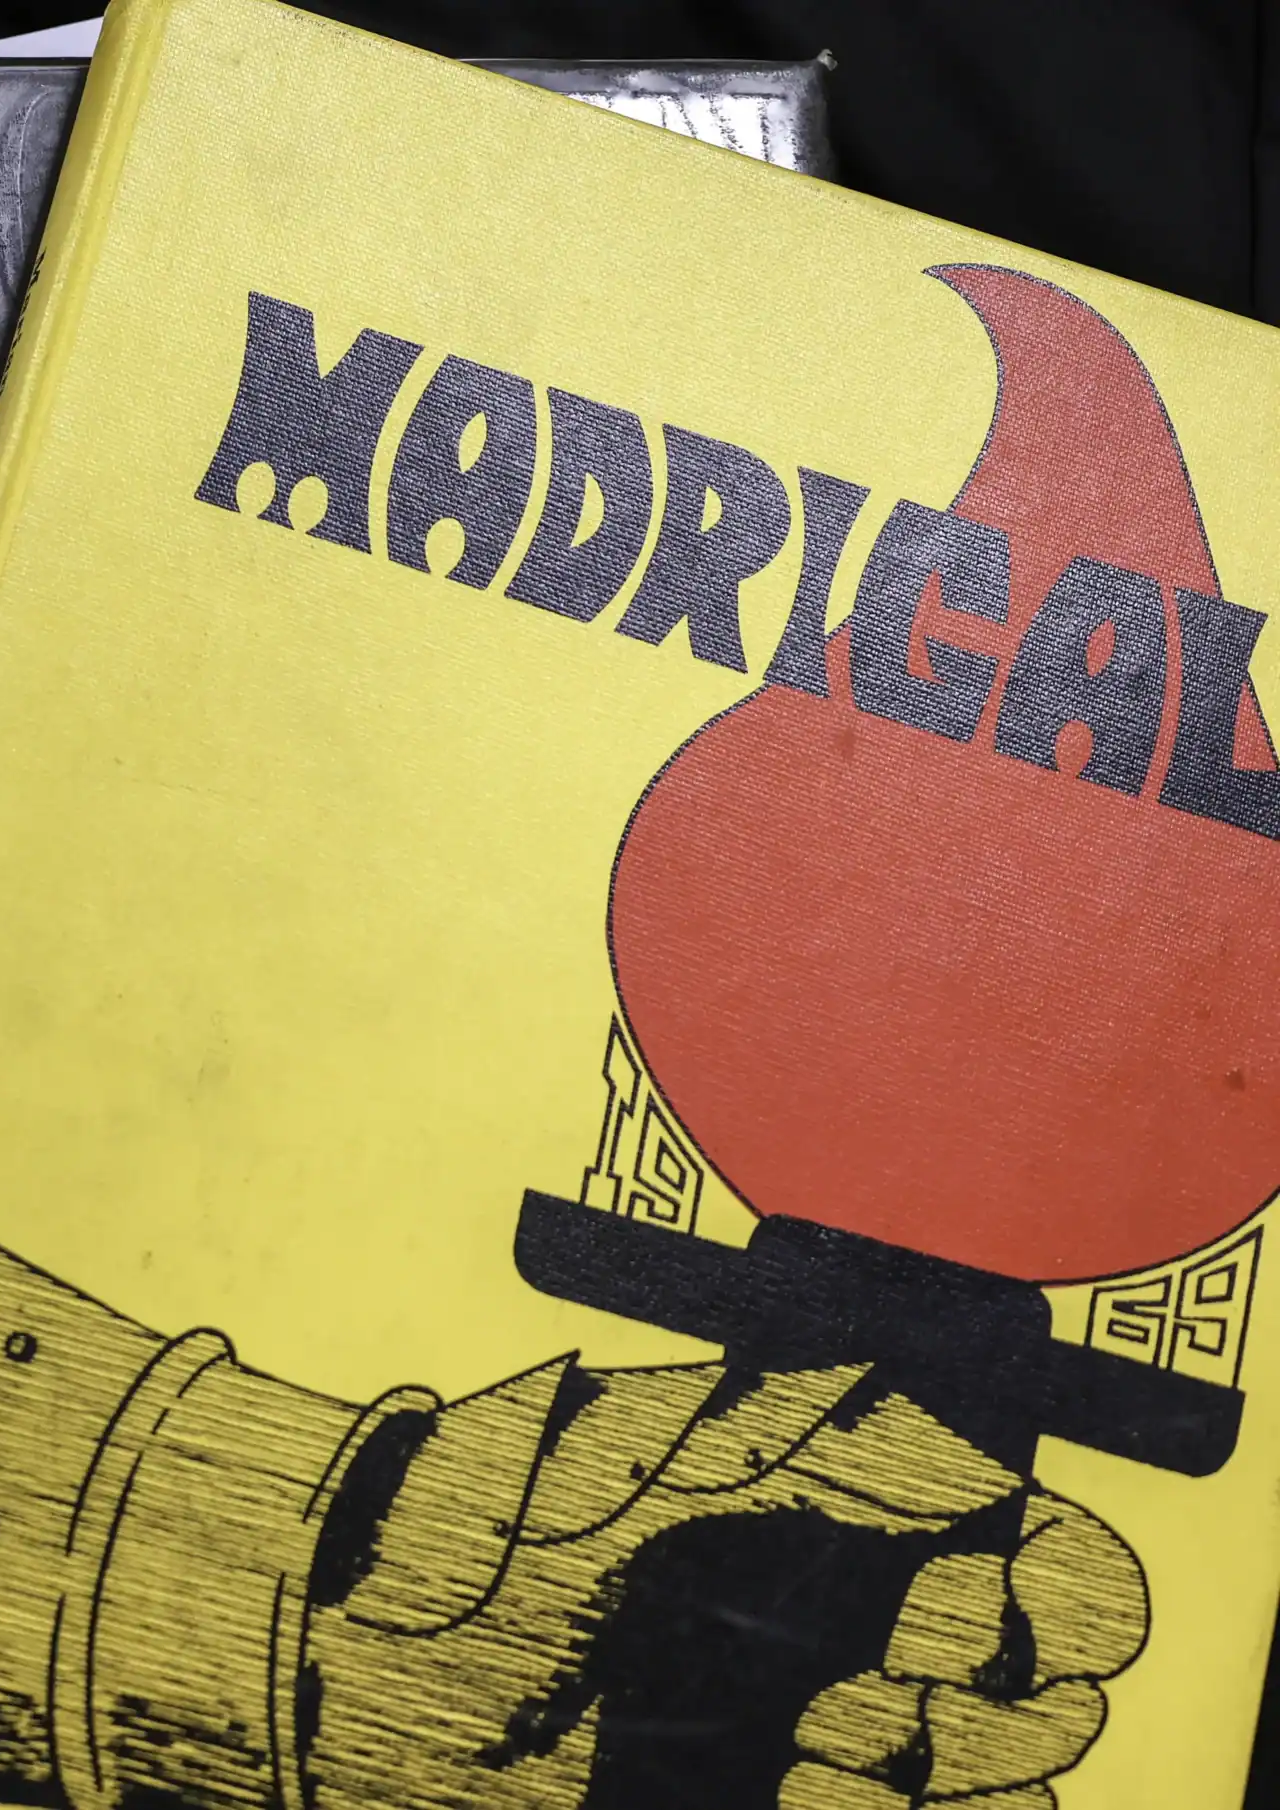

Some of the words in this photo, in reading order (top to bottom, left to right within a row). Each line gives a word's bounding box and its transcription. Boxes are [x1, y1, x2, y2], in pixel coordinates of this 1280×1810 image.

[193, 291, 1280, 841] MADRIGAL
[581, 1010, 704, 1237] 19
[1083, 1224, 1264, 1389] 69
